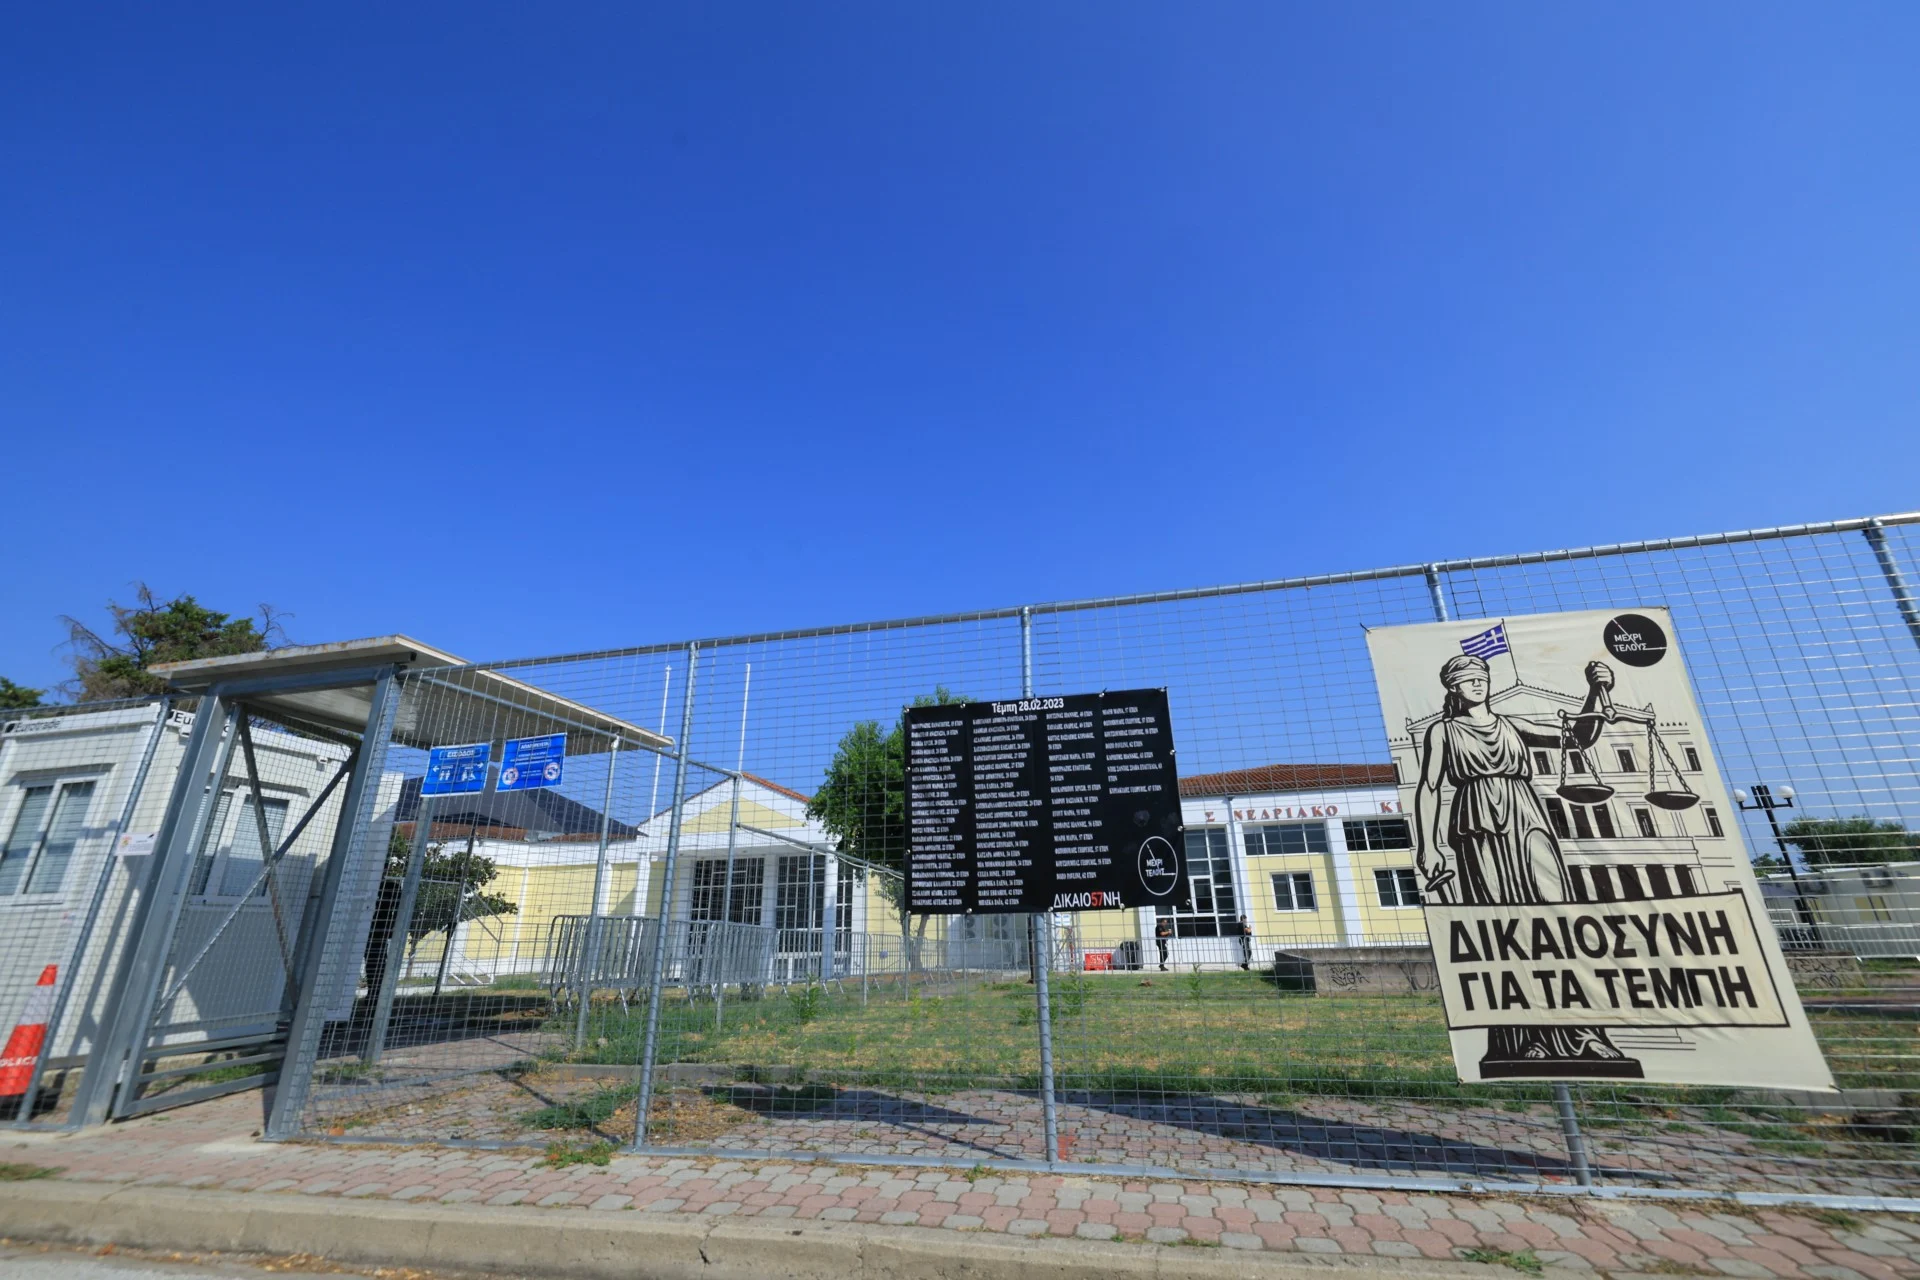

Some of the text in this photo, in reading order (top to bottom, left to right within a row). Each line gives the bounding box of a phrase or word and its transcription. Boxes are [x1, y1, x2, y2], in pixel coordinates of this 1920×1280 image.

[1614, 633, 1642, 642] ΜΕΧΡΙ
[1613, 643, 1647, 652] ΤΕΛΟΥΣ
[992, 698, 1064, 716] Τέμπη 28.02.2023
[1053, 891, 1120, 908] ΔΙΚΑΙΟ57ΝΗ
[1450, 910, 1739, 963] ΔΙΚΑΙΟΣΥΝΗ
[1458, 970, 1531, 1011] ΓΙΑ
[1533, 969, 1592, 1009] ΤΑ
[1595, 966, 1758, 1009] ΤΕΜΠΗ
